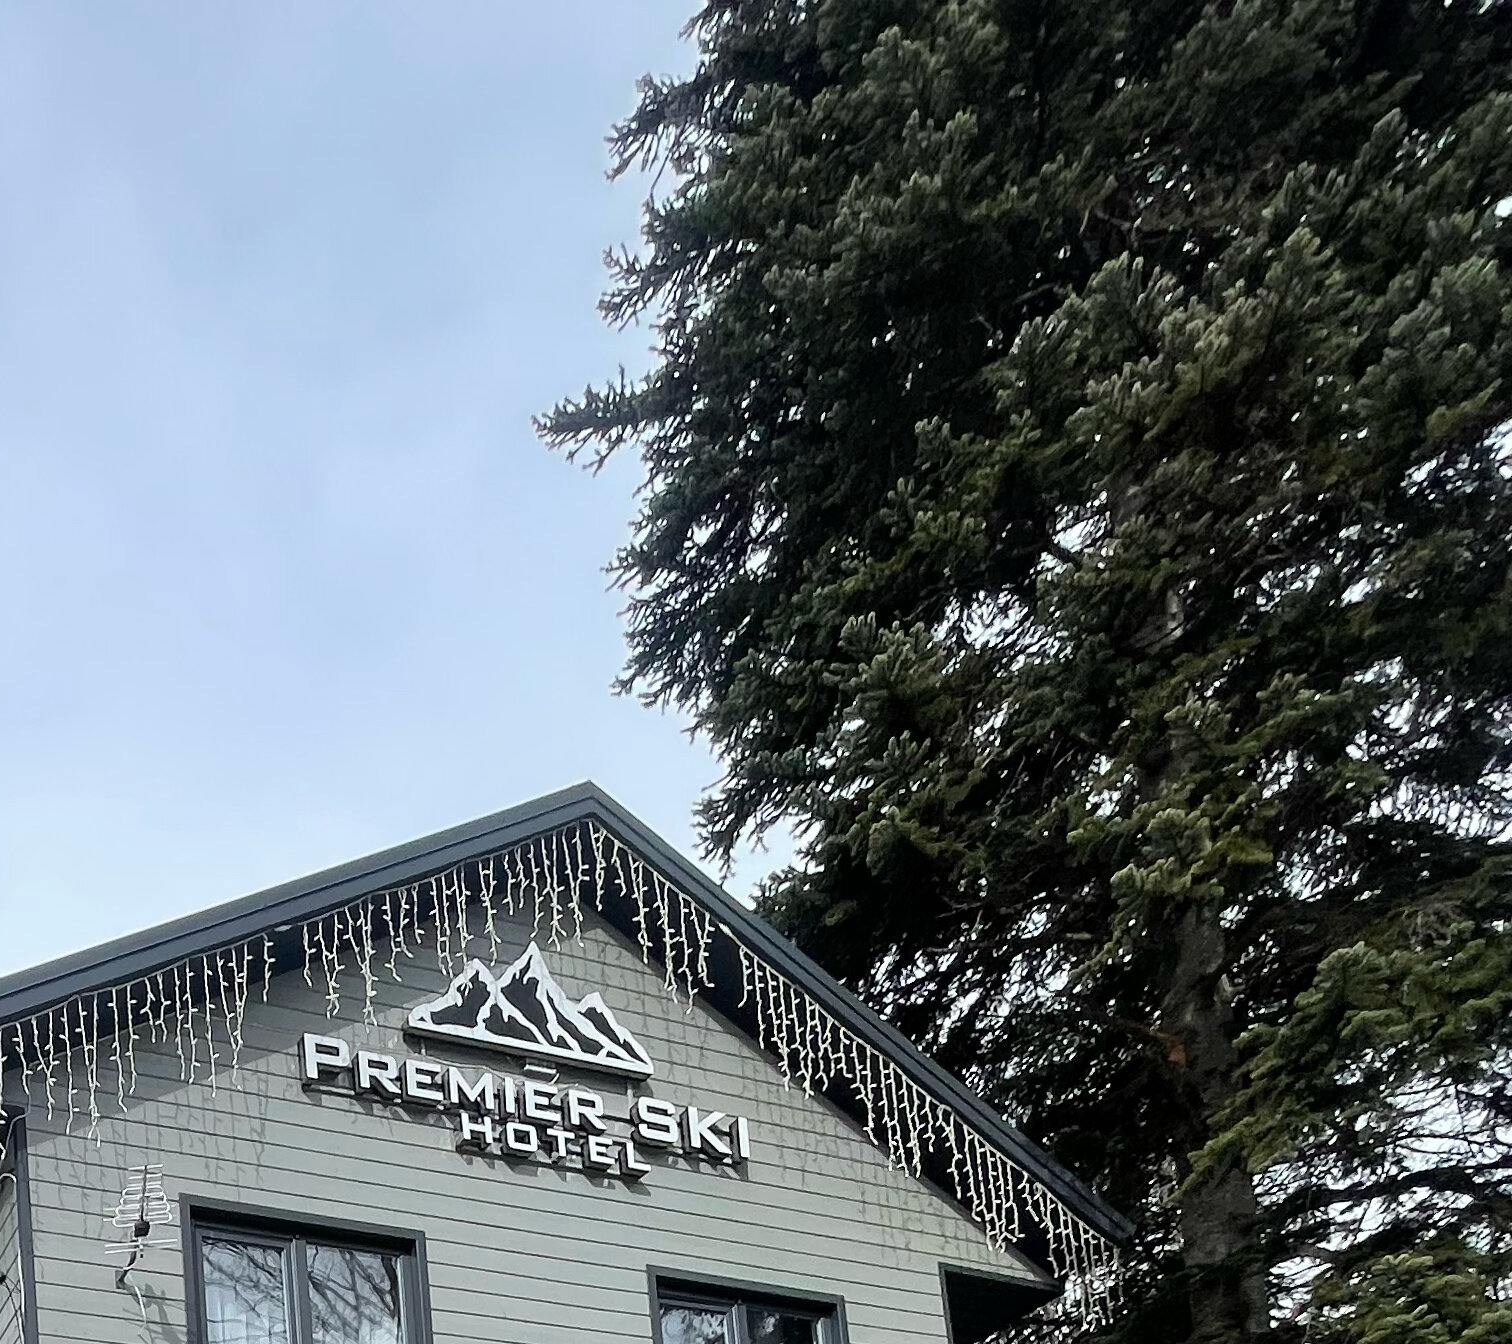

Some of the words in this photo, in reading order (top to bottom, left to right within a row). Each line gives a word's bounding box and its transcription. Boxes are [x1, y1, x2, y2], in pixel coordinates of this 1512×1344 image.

[302, 1032, 607, 1131] PREMIER
[637, 1096, 751, 1159] SKI
[461, 1112, 652, 1172] HOTEL
